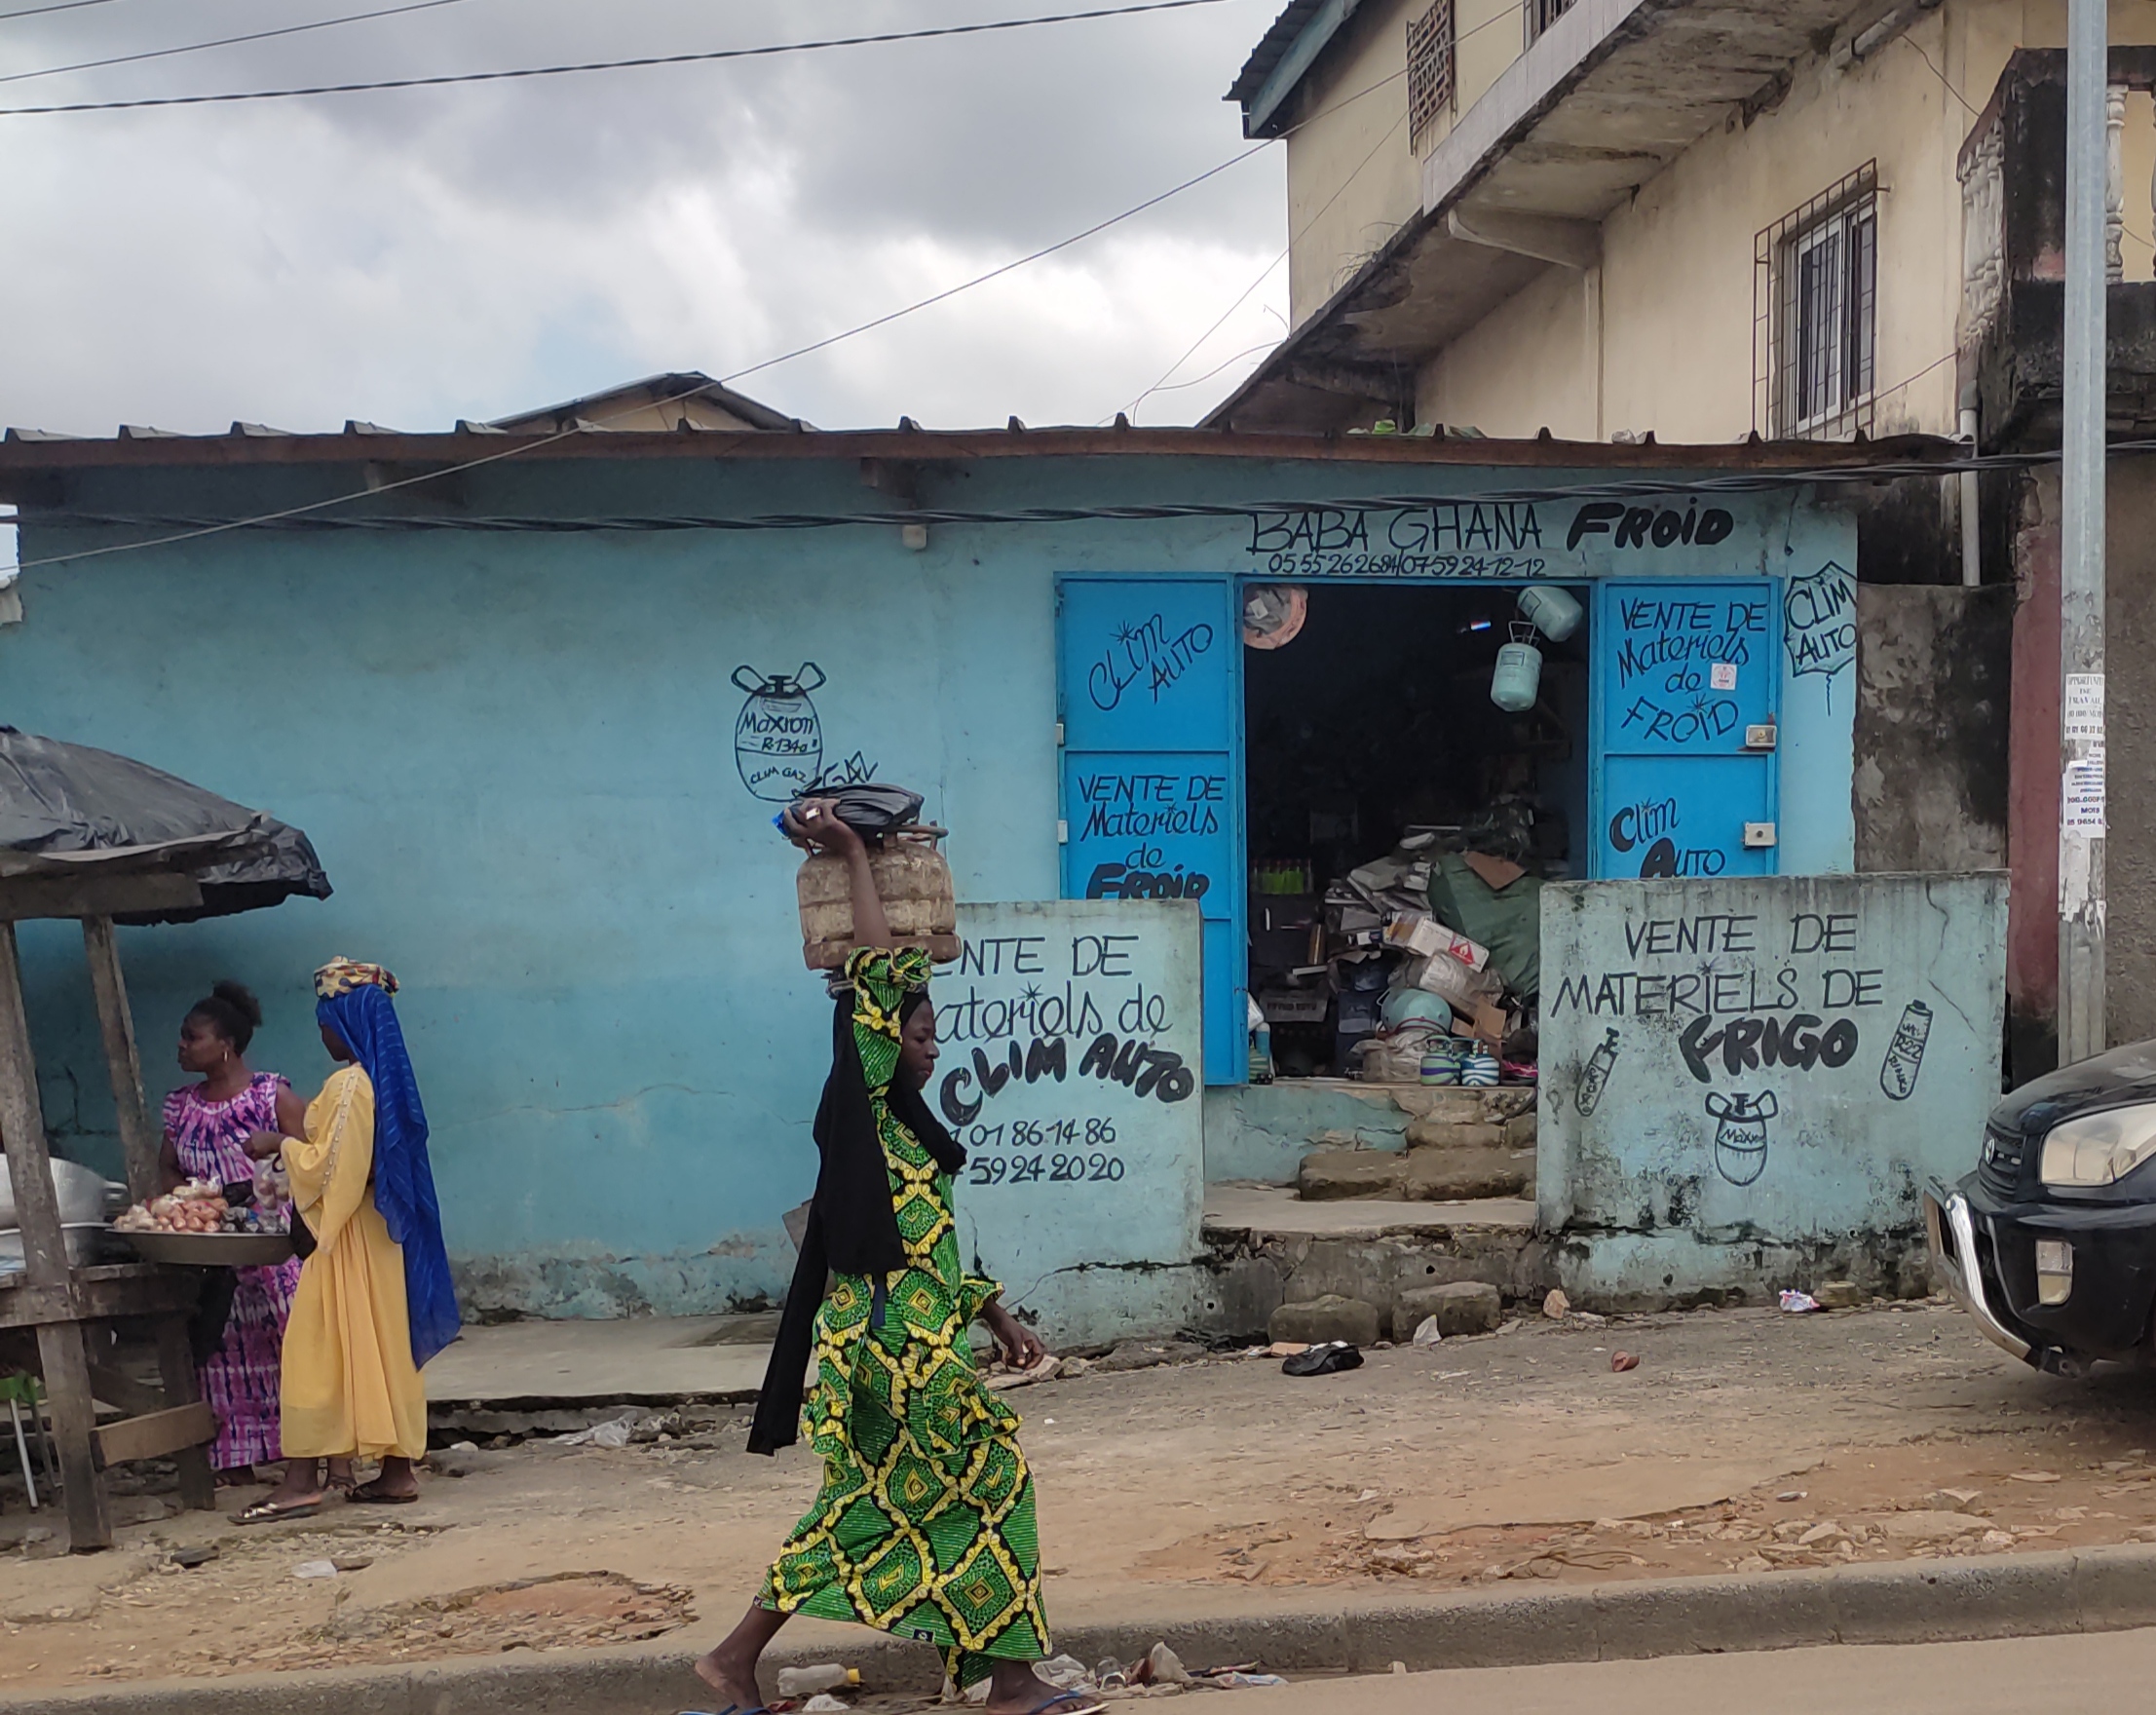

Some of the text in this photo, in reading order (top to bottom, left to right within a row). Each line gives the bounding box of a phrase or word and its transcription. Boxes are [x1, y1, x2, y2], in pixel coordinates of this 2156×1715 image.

[1246, 511, 1369, 555] BABA
[1388, 503, 1542, 553] GHANA
[1620, 596, 1768, 633] VENTE DE
[1148, 623, 1214, 705] AUTO
[1796, 623, 1858, 666] AUTO
[1664, 663, 1705, 695] de
[1078, 773, 1227, 804] VENTE DE
[1124, 842, 1167, 870] de
[932, 934, 1140, 977] NTE DE
[1624, 913, 1859, 961] VENTE DE
[1822, 968, 1884, 1010] DE
[933, 978, 1174, 1045] ateriels de
[1678, 1013, 1860, 1085] FRIGO
[939, 1032, 1195, 1127] CLIM AUTO
